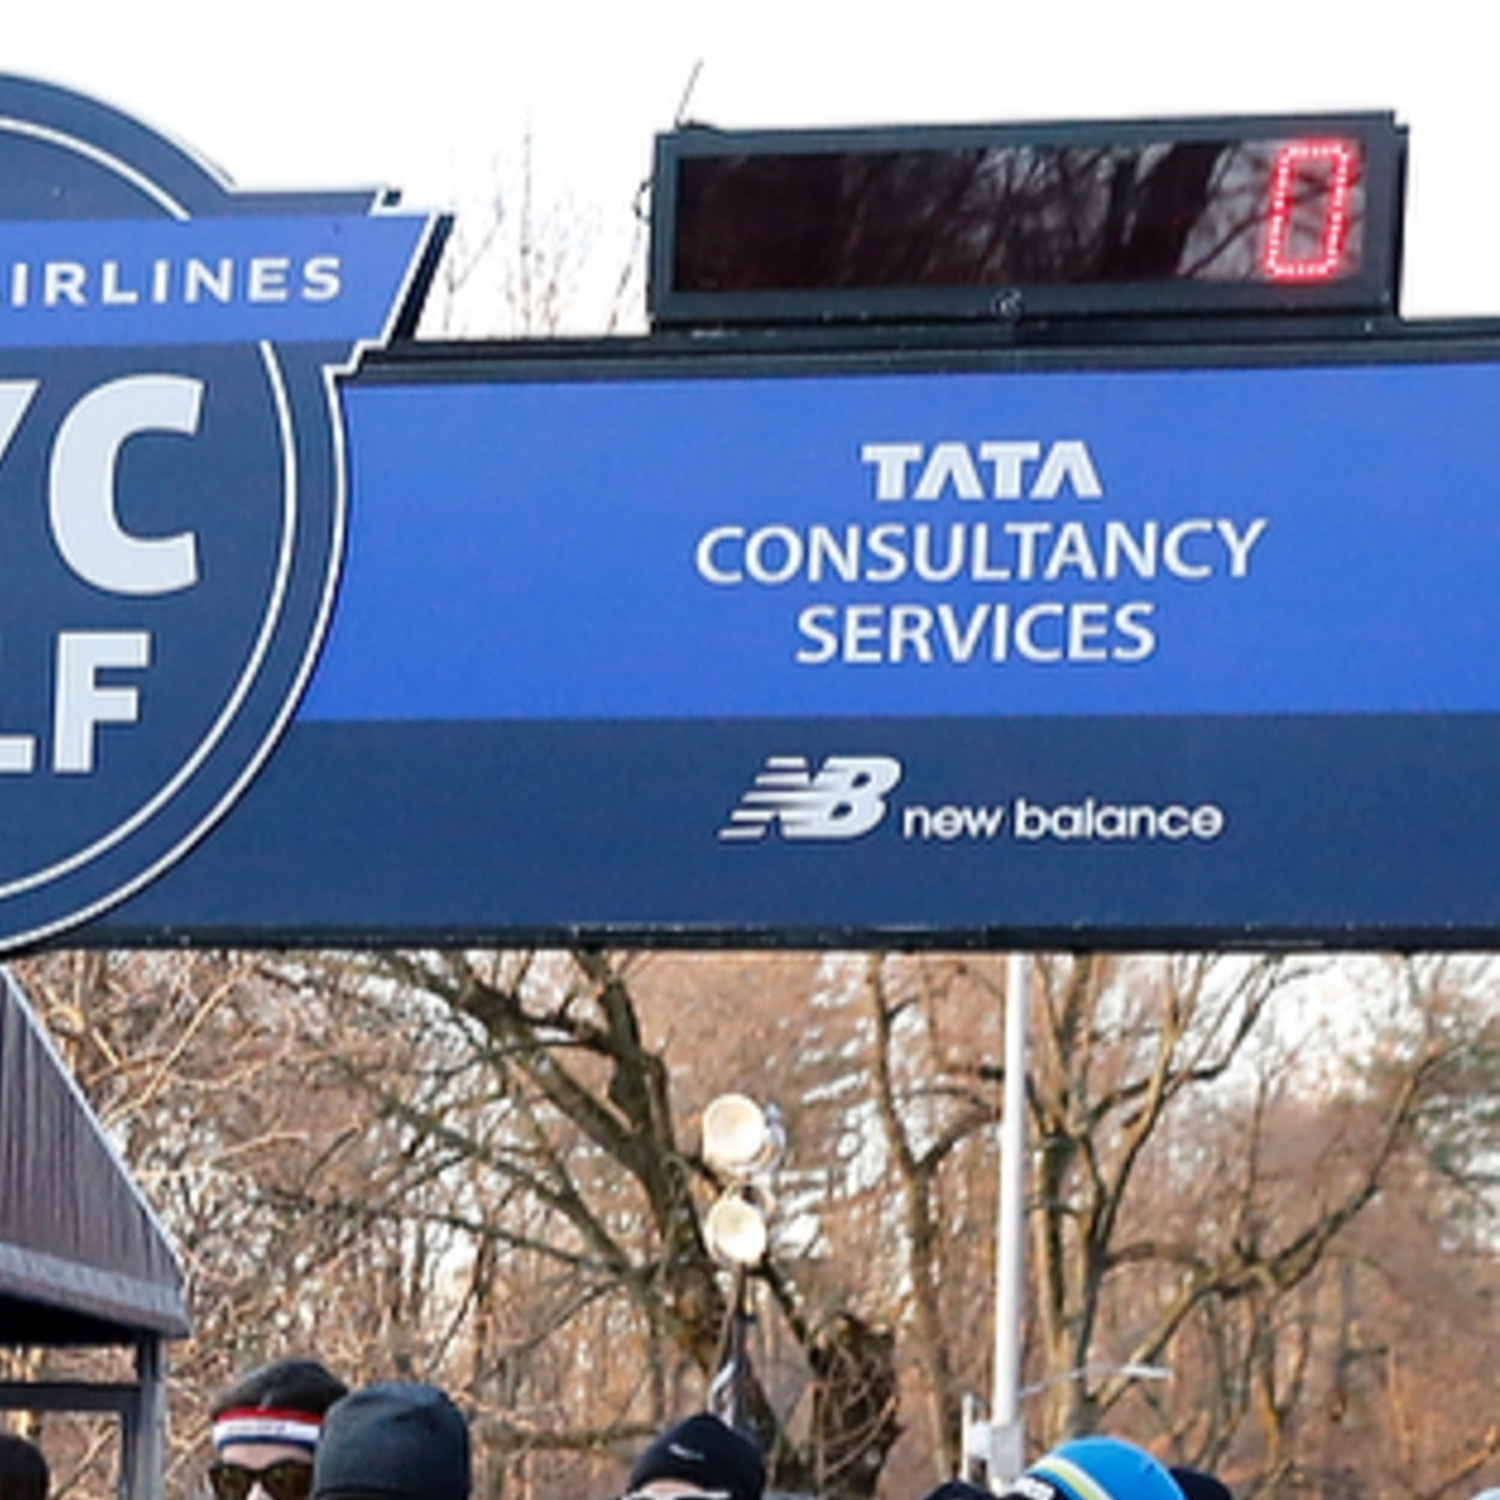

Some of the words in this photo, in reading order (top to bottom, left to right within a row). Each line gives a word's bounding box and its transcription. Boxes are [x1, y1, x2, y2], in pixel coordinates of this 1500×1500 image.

[1265, 140, 1351, 279] 0
[861, 440, 1103, 501] TATA
[696, 518, 1267, 584] CONSULTANCY
[796, 602, 1156, 664] SERVICES
[904, 806, 1003, 839] new
[1015, 798, 1223, 839] balance
